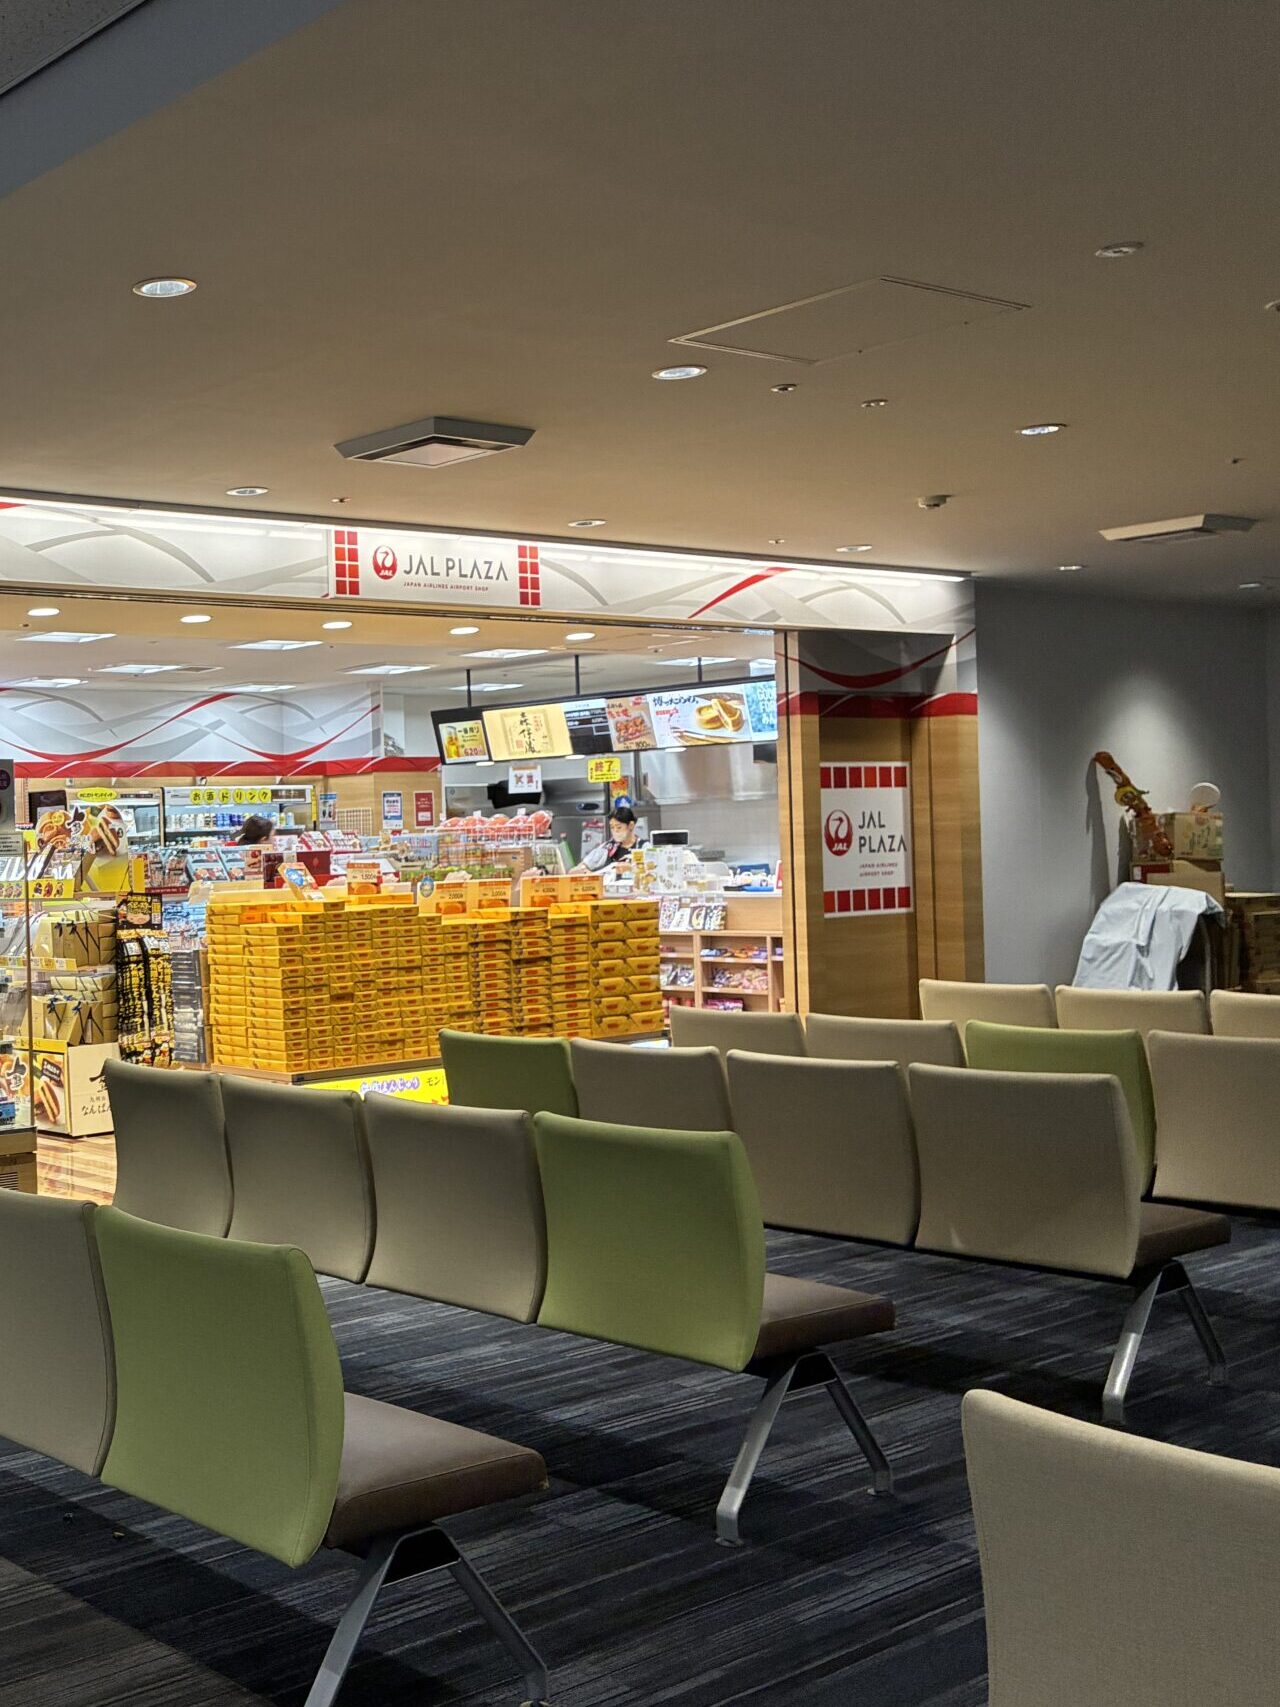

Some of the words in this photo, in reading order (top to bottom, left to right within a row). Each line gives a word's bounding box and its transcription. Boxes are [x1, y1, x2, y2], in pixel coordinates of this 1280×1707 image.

[403, 554, 440, 576] JAL
[445, 557, 508, 581] PLAZA
[858, 810, 886, 829] JAL
[832, 842, 849, 851] JAL
[858, 834, 908, 854] PLAZA
